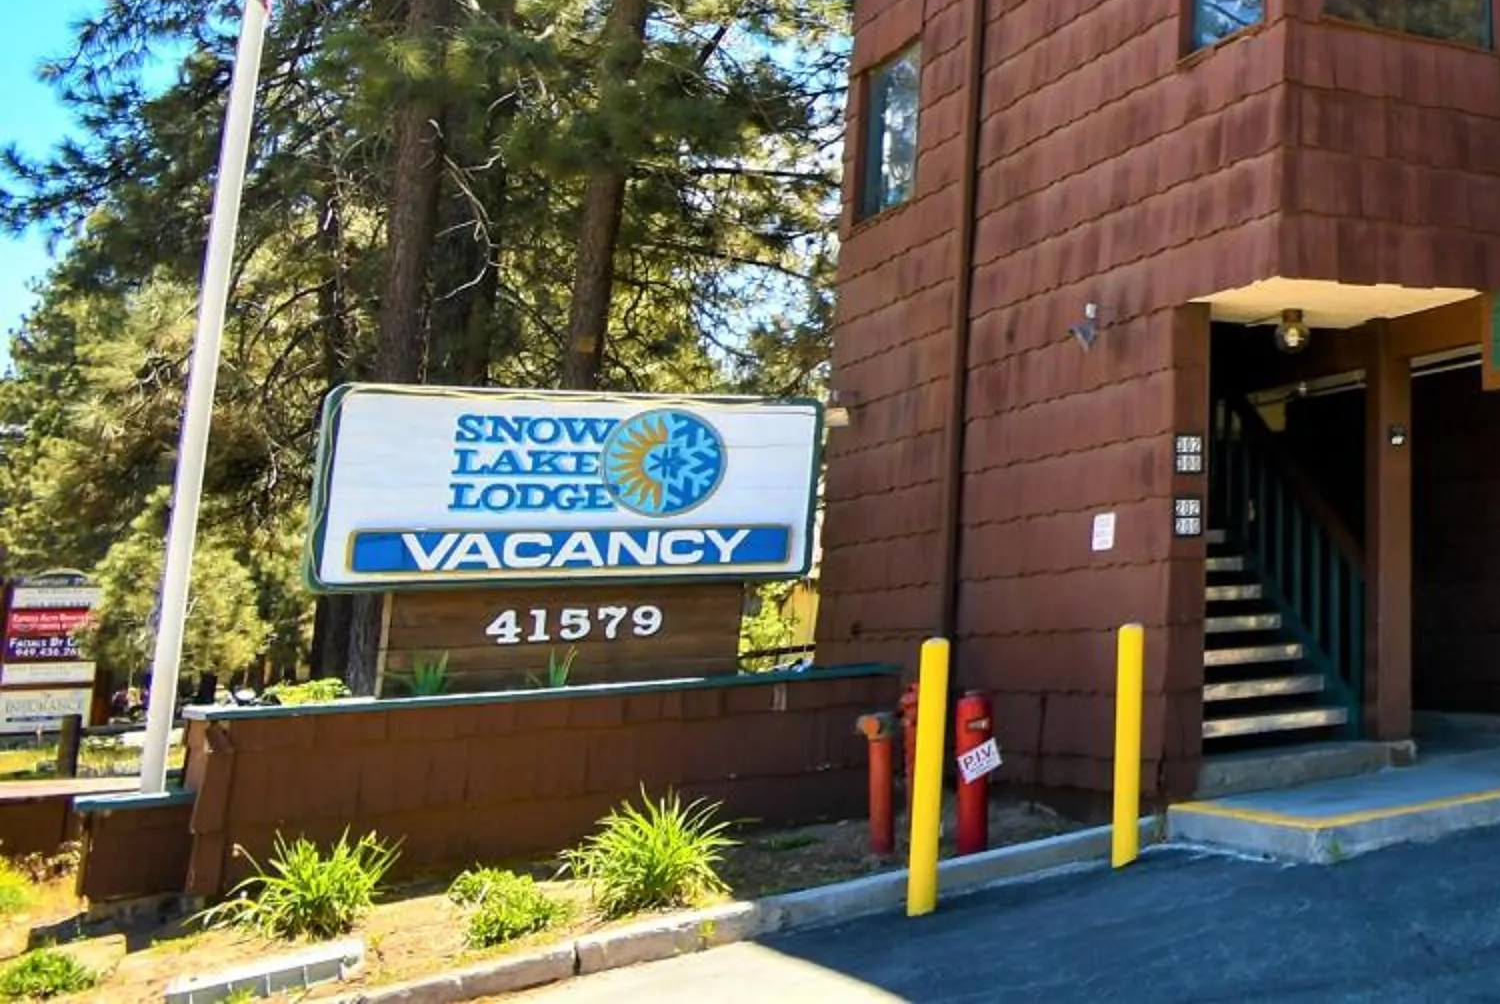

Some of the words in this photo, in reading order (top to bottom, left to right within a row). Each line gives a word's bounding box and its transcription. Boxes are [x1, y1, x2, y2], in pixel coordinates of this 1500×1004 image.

[455, 414, 620, 444] SNOW
[451, 449, 601, 475] LAKE
[448, 483, 620, 511] LODGE
[400, 529, 751, 571] VACANCY
[485, 605, 664, 645] 41579
